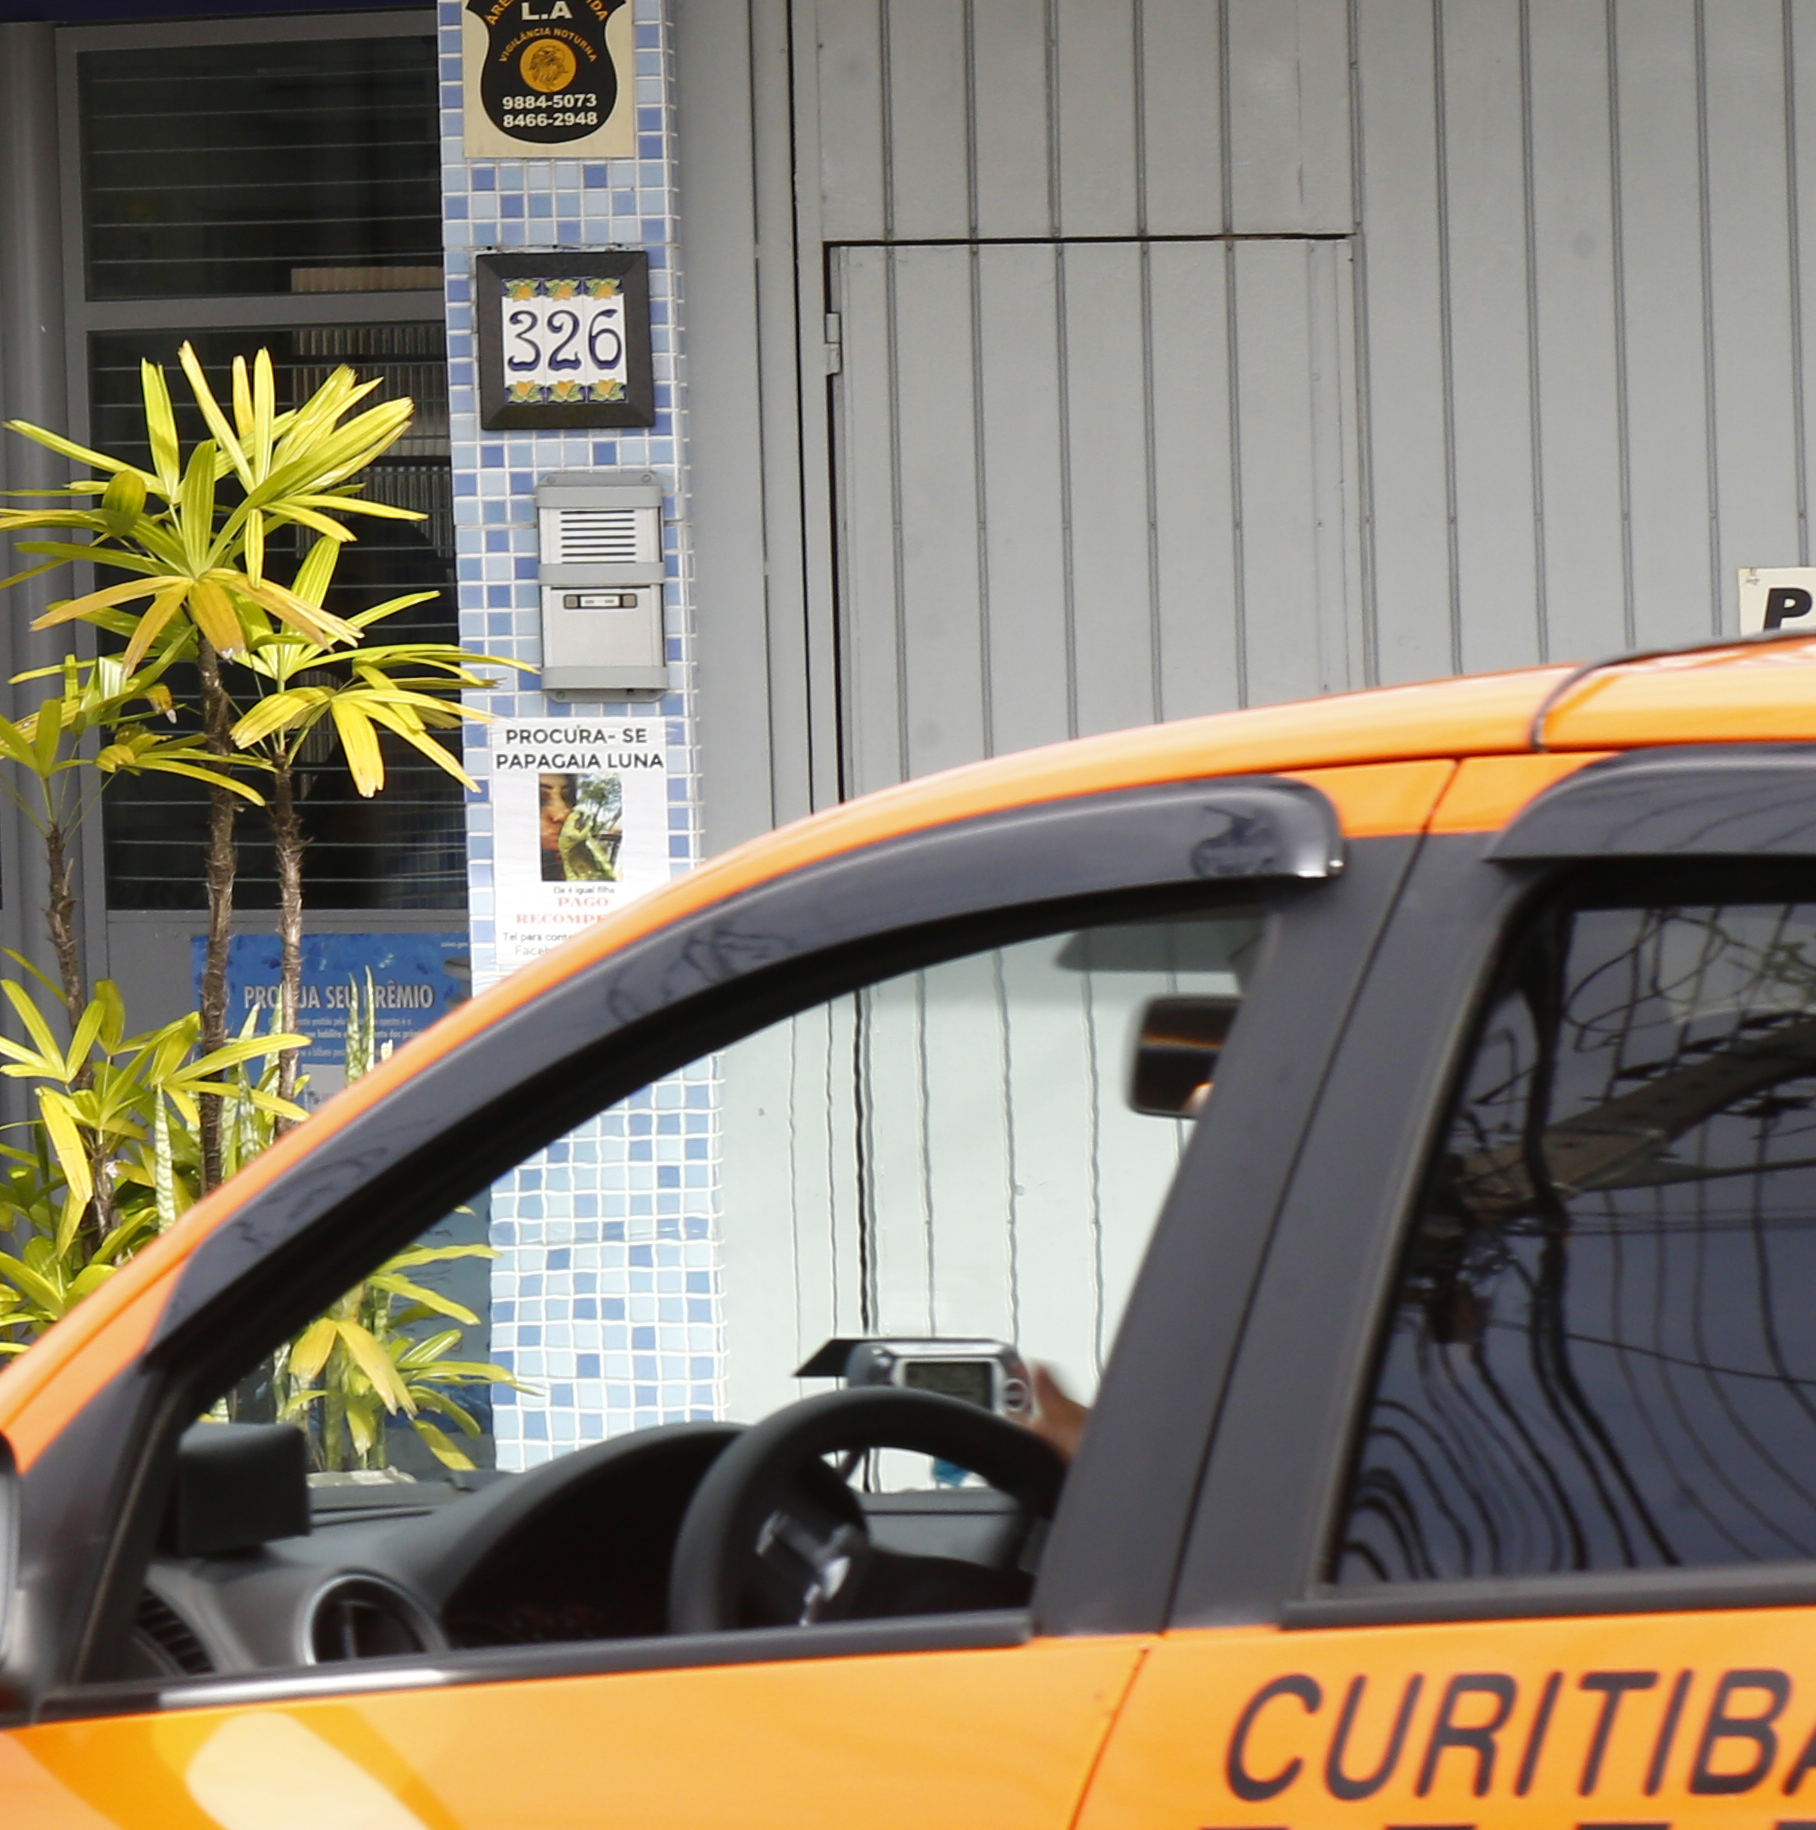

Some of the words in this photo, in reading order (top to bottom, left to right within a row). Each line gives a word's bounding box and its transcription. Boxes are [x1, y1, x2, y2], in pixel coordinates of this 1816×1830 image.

[521, 0, 573, 21] L.A
[499, 27, 552, 62] VIGILÂNCIA
[553, 27, 598, 62] NOTURNA
[502, 93, 598, 110] 9884-5073
[502, 111, 599, 128] 8466-2948
[506, 308, 623, 372] 326
[622, 727, 648, 745] SE
[495, 753, 603, 771] PAPAGAIA
[607, 752, 664, 770] LUNA
[557, 896, 610, 908] PAGO
[516, 913, 606, 925] RECOMPE
[243, 984, 322, 1009] PROJA
